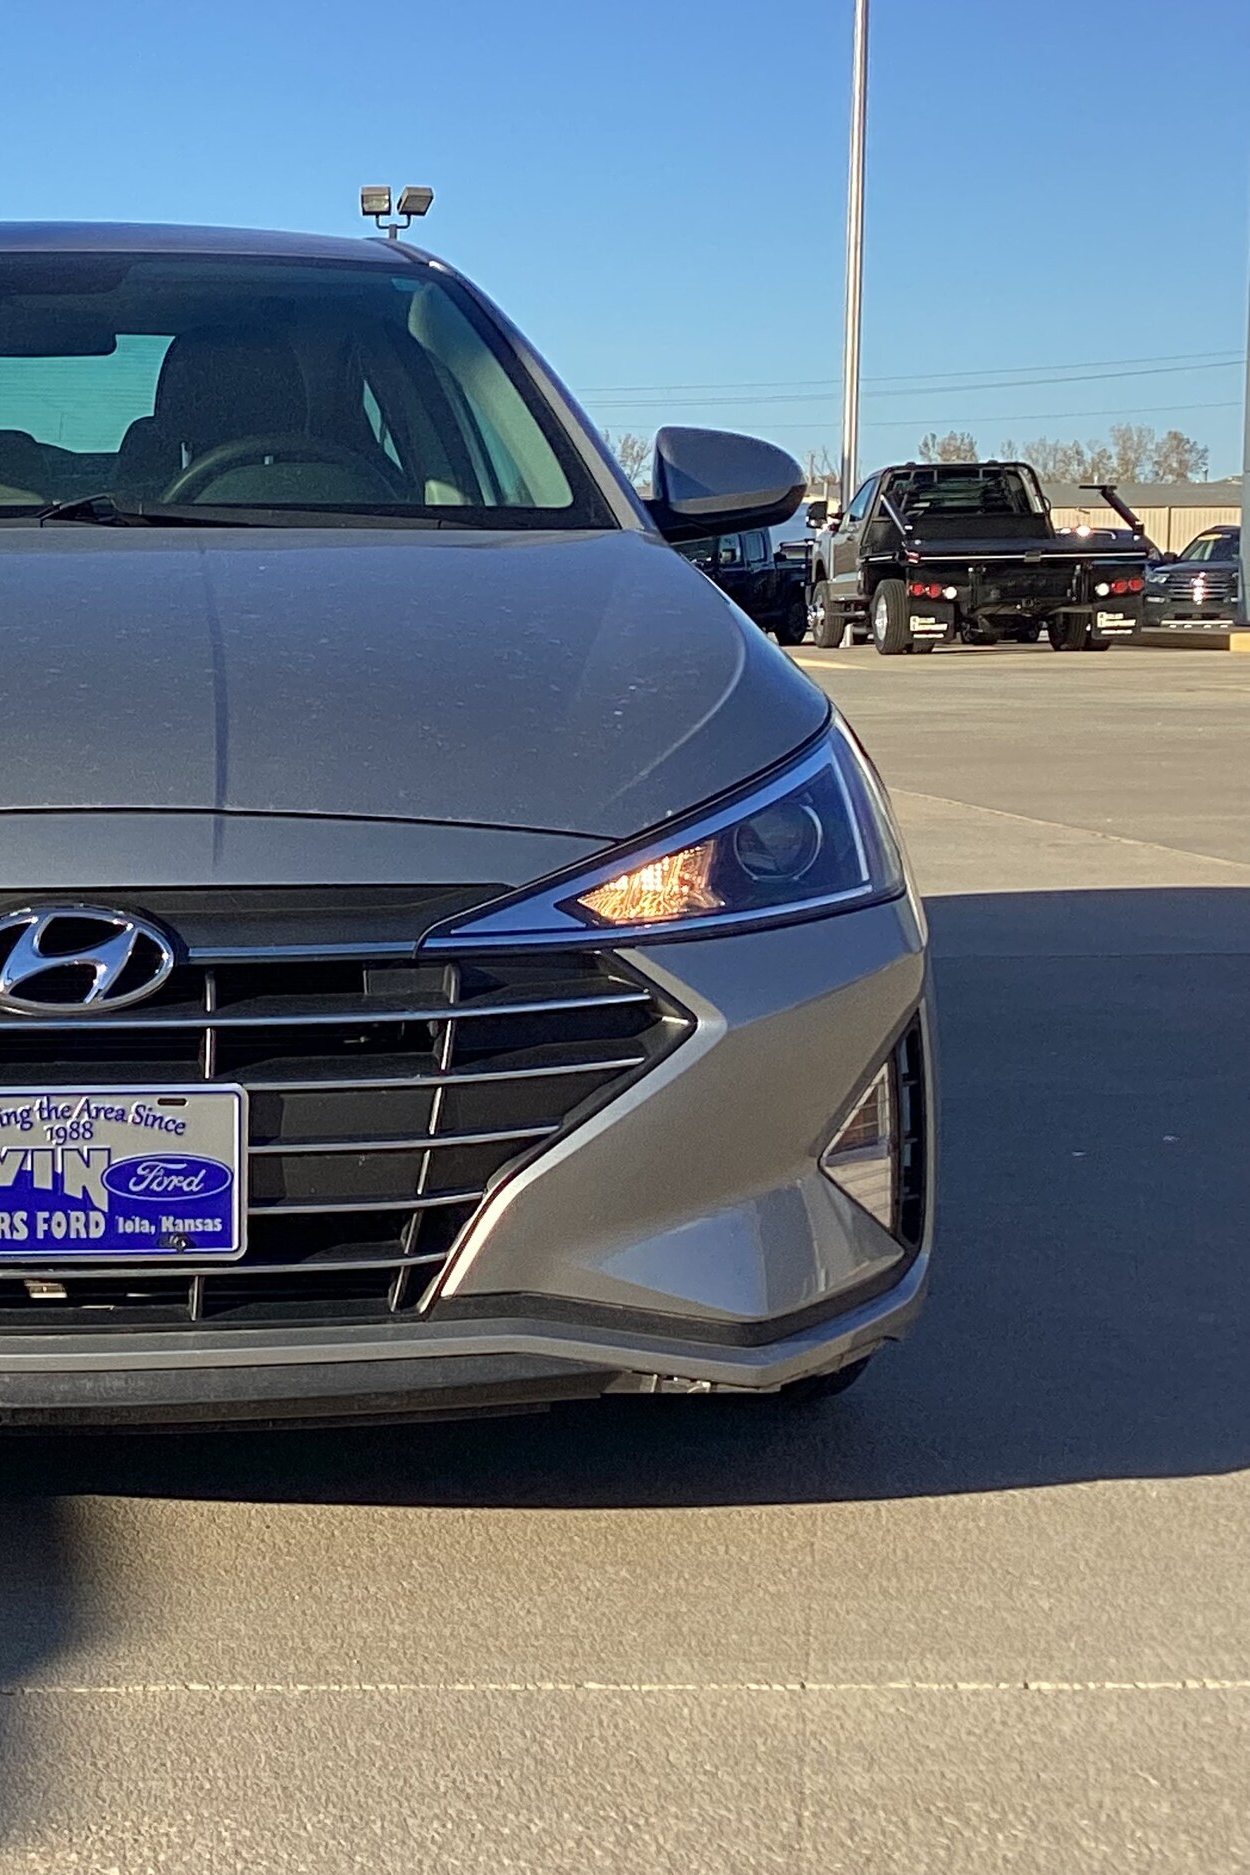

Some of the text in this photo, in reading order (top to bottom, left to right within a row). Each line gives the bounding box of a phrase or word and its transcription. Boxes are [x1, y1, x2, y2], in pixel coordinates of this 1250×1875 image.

[35, 1096, 73, 1121] the
[75, 1098, 128, 1124] Area
[131, 1103, 187, 1136] Since
[45, 1120, 94, 1146] 1988
[129, 1161, 206, 1192] Ford
[36, 1211, 106, 1240] FORD
[116, 1215, 223, 1235] Iola, Kansas
